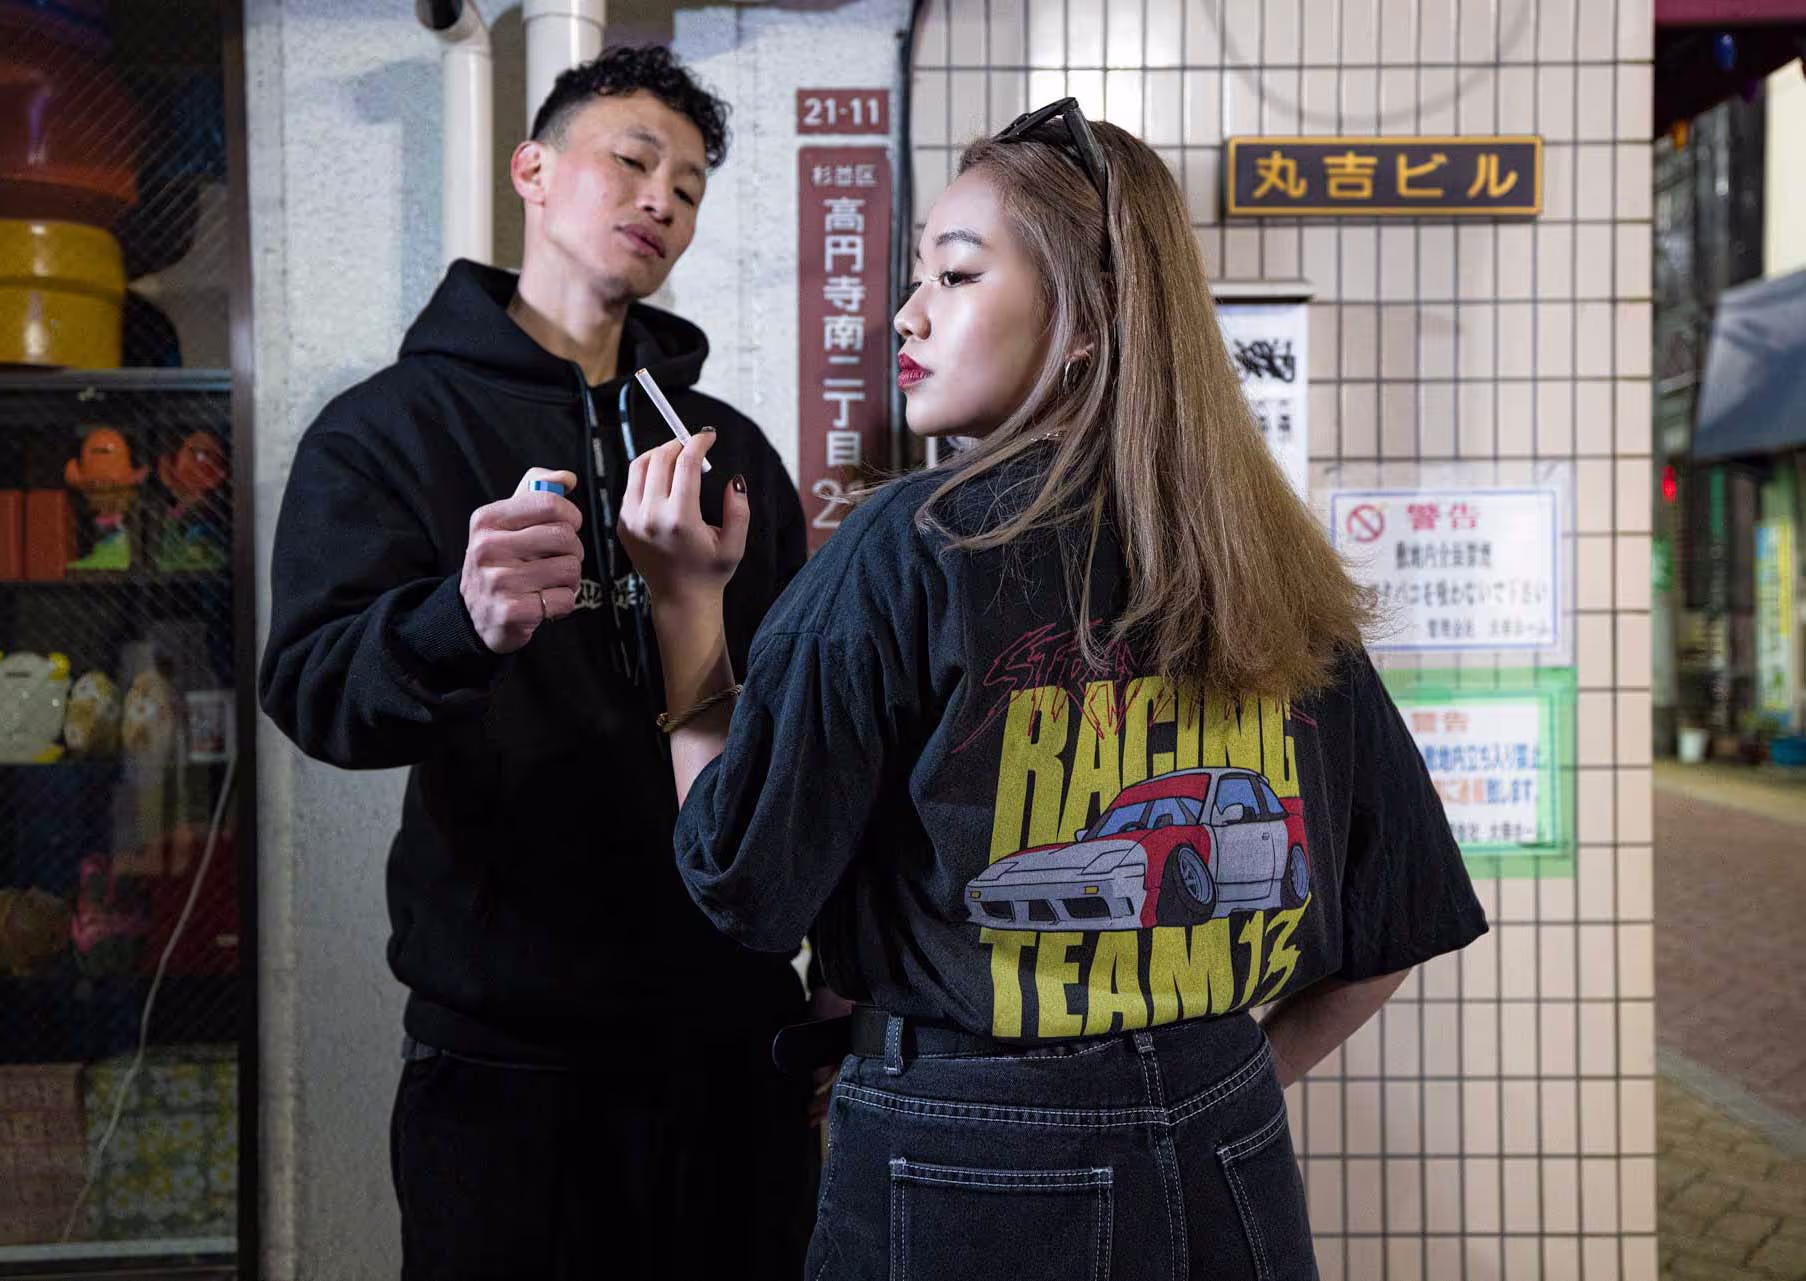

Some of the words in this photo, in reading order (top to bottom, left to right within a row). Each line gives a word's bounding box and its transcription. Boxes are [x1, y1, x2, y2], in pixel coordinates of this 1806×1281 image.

[812, 164, 877, 188] 杉並区
[1252, 150, 1518, 199] 丸吉ビル
[822, 196, 866, 467] 高円寺南二丁目
[1406, 502, 1480, 531] 警告
[988, 675, 1301, 866] RACING
[979, 916, 1237, 1039] TEAM
